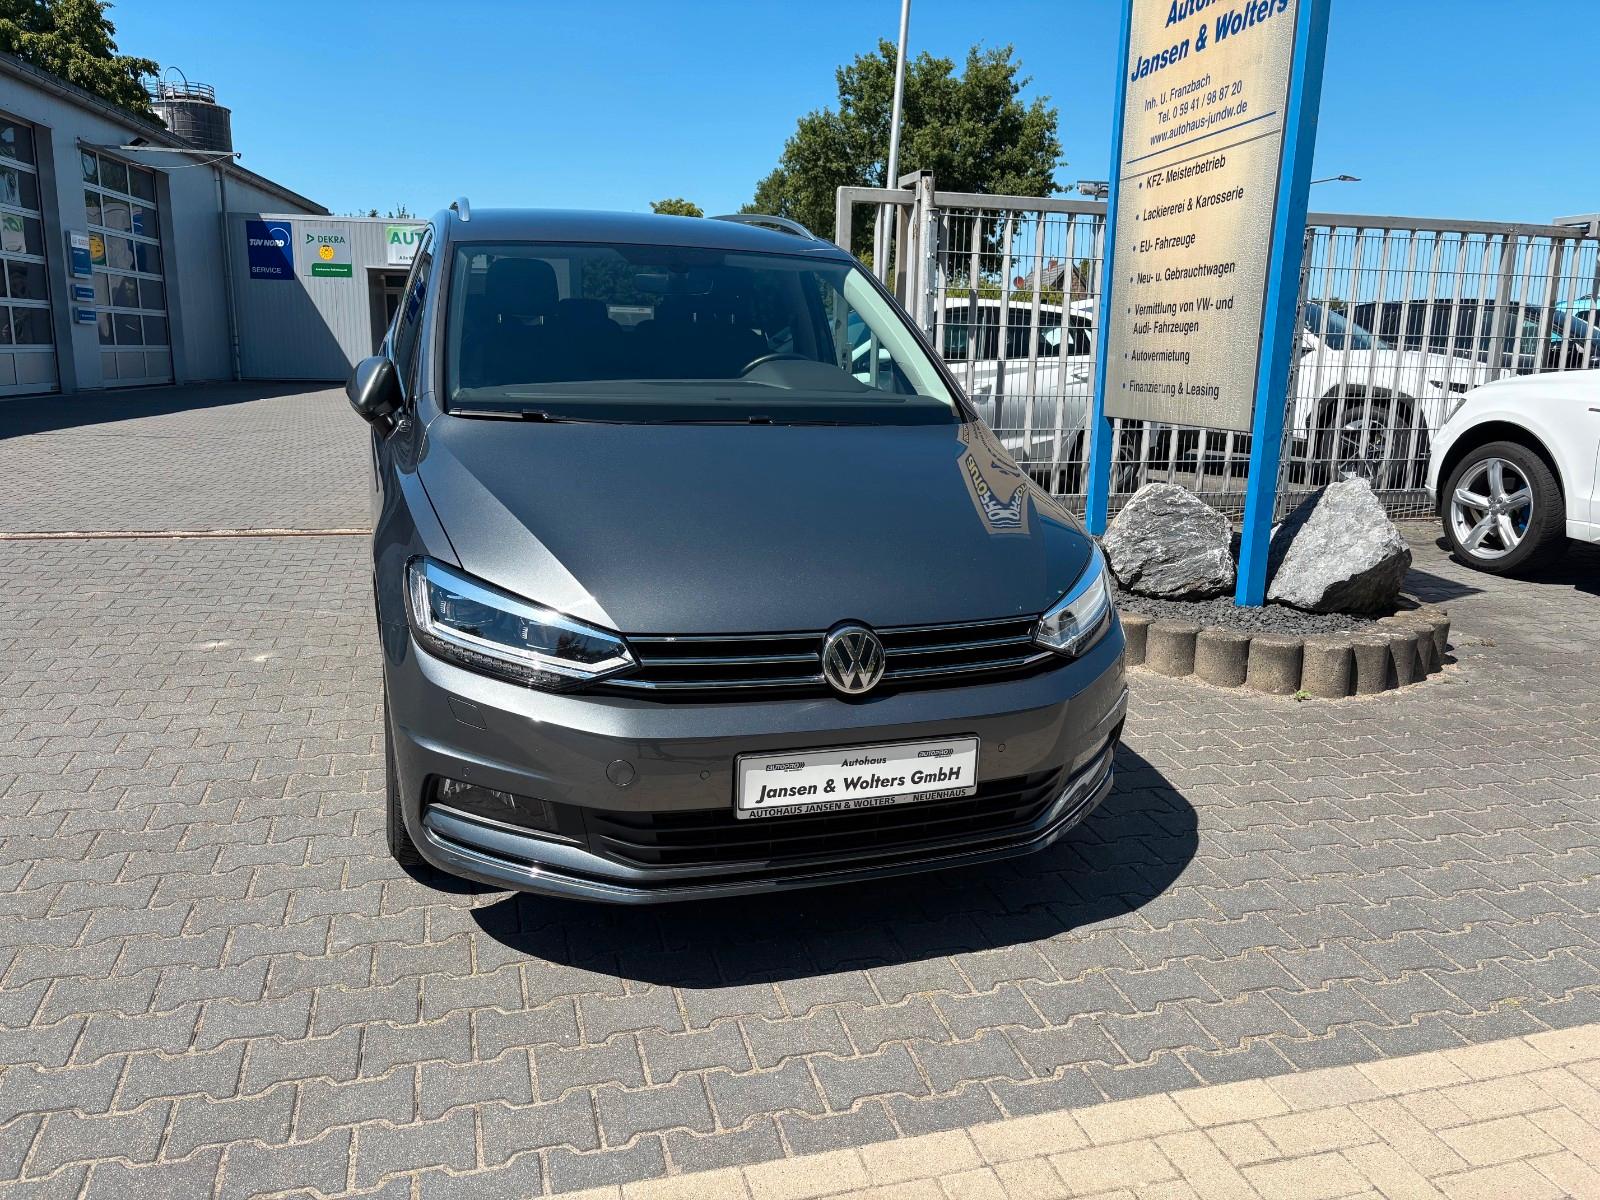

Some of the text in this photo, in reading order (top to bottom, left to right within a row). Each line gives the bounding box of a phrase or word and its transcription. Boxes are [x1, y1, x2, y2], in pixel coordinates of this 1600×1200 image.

[1131, 0, 1289, 82] Jansen & Wolters
[1144, 73, 1211, 112] Inh. U. Franzbach
[1158, 109, 1171, 125] Tel.
[1172, 106, 1178, 119] 0
[1179, 102, 1189, 117] 59
[1190, 97, 1200, 112] 41
[1206, 91, 1217, 106] 98
[1218, 84, 1230, 101] 87
[1231, 80, 1243, 97] 20
[1150, 100, 1248, 146] www.autohaus-jundw.de
[1146, 154, 1226, 189] KFZ- Meisterbetrieb
[1143, 185, 1244, 221] Lackiererei & Karosserie
[263, 239, 285, 248] NORD
[317, 235, 345, 244] DEKRA
[390, 231, 423, 246] AUT
[1140, 233, 1196, 252] EU- Fahrzeuge
[252, 266, 282, 274] SERVICE
[1136, 261, 1236, 284] Neu- u. Gebrauchtwagen
[1134, 296, 1234, 316] Vermittlung von VW- und
[1133, 321, 1199, 336] Audi- Fahrzeugen
[1131, 350, 1190, 364] Autovermietung
[1129, 380, 1220, 400] Finanzierung & Leasing
[841, 756, 887, 768] Autohaus
[755, 767, 962, 804] Jansen & Wolters GmbH
[749, 789, 967, 819] AUTOHAUS JANSEN & WOLTERS NEUENHAUS
